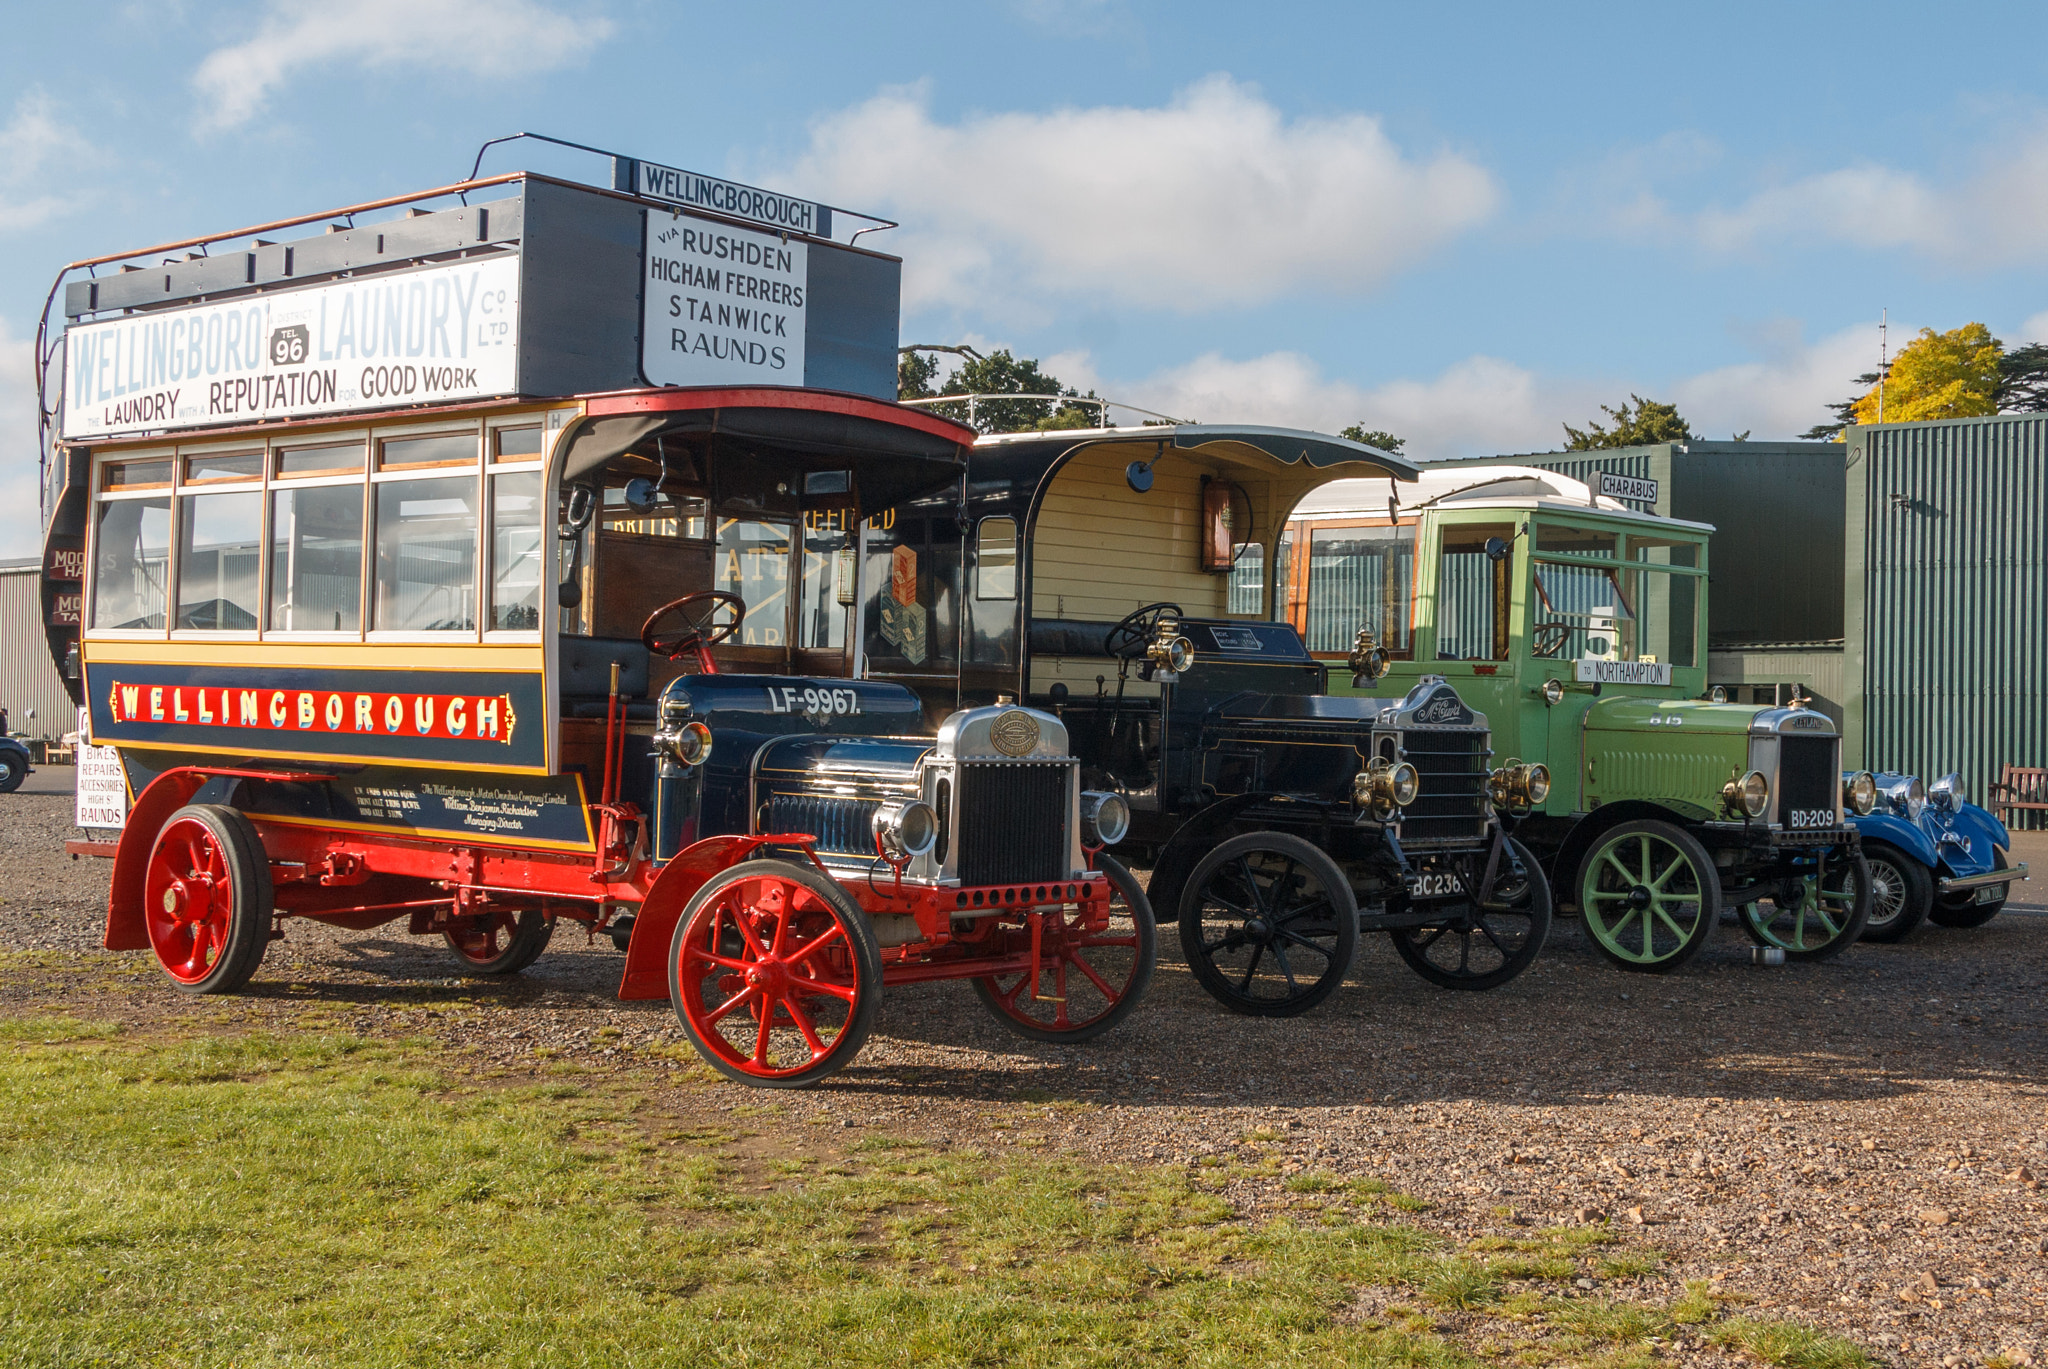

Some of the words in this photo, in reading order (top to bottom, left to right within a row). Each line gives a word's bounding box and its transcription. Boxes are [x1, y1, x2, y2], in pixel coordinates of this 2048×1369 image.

[646, 166, 812, 230] WELLINGBOROUGH
[658, 227, 679, 244] VIA
[683, 228, 792, 273] RUSHDEN
[652, 256, 720, 292] HIGHAM
[726, 272, 804, 308] FERRERS
[278, 309, 312, 323] DISTRICT
[319, 271, 480, 361] LAUNDRY
[669, 295, 787, 338] STANWICK
[276, 338, 303, 363] 96
[671, 328, 786, 369] RAUNDS
[87, 417, 100, 428] THE
[105, 389, 180, 425] LAUNDRY
[179, 405, 198, 418] WITH
[200, 405, 206, 416] A
[210, 369, 337, 415] REPUTATION
[338, 389, 357, 401] FOR
[361, 365, 417, 399] GOOD
[422, 365, 478, 392] WORK
[552, 414, 560, 429] H
[1603, 477, 1655, 499] CHARABUS
[1584, 666, 1591, 675] TO
[1596, 661, 1663, 684] NORTHAMPTON
[121, 686, 498, 738] WELLINGBOROUGH
[87, 748, 117, 760] BIKES
[83, 764, 121, 776] REPAIRS
[80, 779, 124, 792] ACCESSORIES
[421, 783, 433, 794] The
[519, 790, 544, 807] Company
[88, 795, 104, 804] HIGH
[81, 808, 121, 823] RAUNDS
[1792, 810, 1834, 827] BD-209
[1413, 875, 1432, 896] BC
